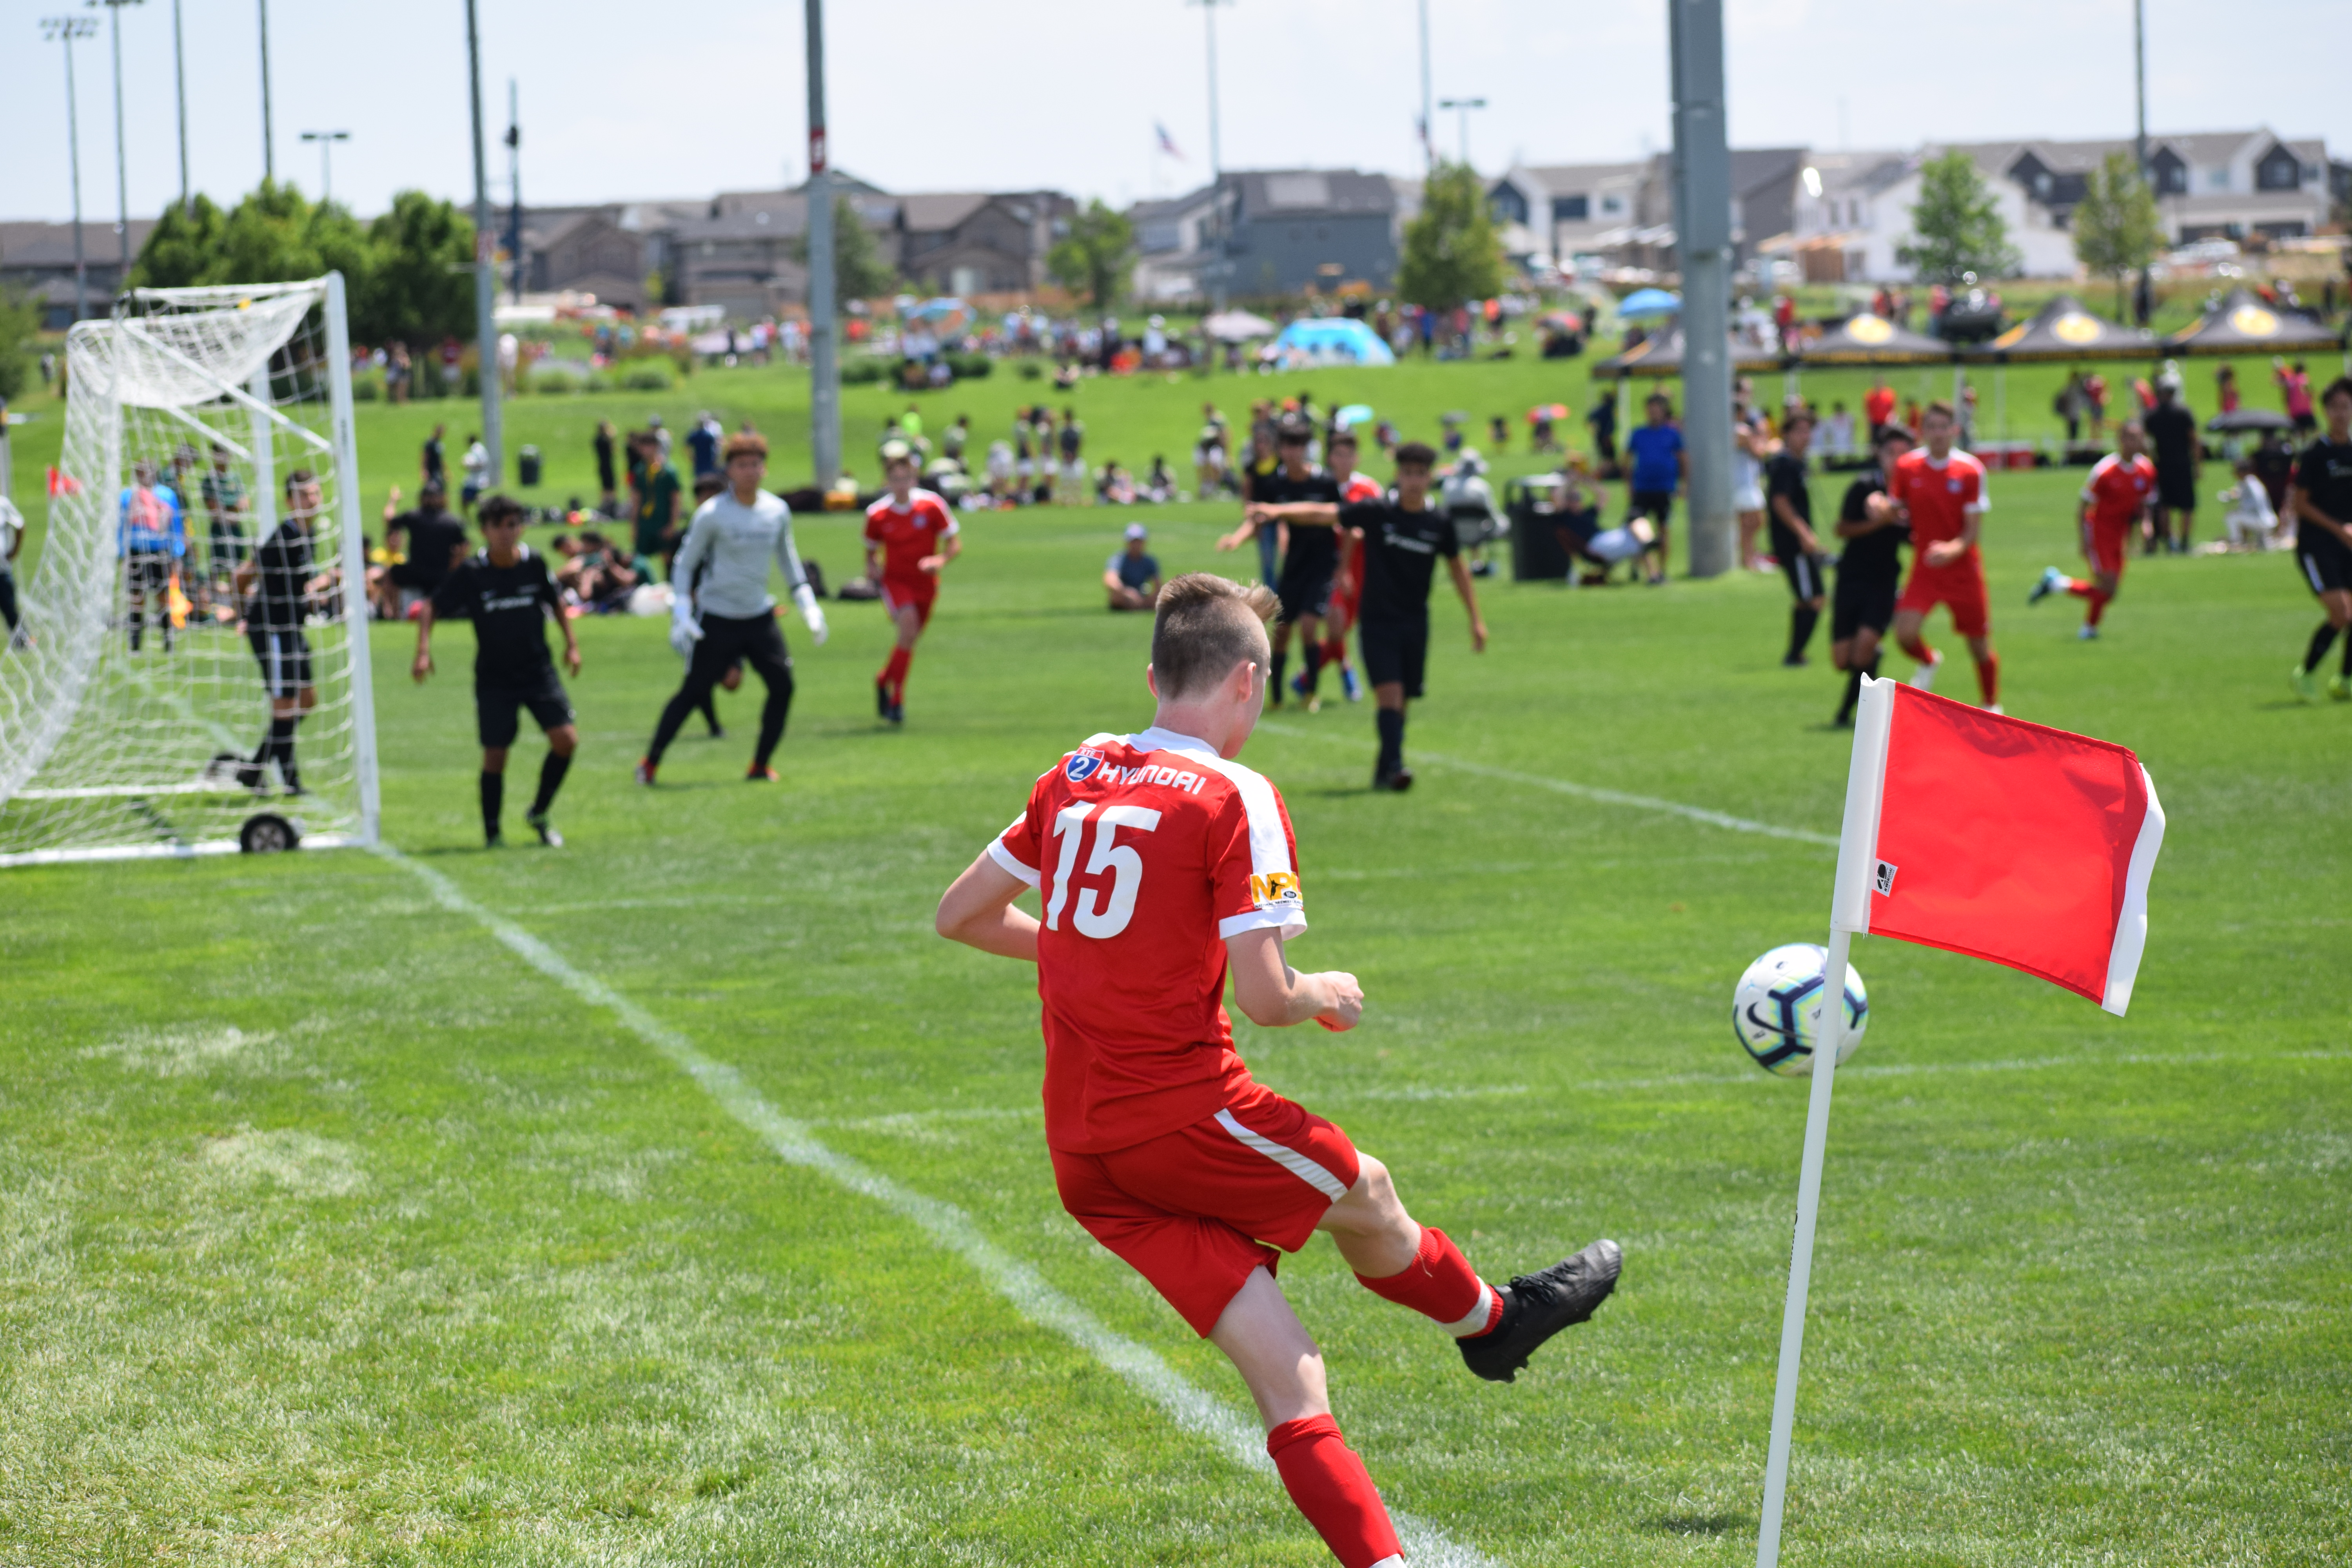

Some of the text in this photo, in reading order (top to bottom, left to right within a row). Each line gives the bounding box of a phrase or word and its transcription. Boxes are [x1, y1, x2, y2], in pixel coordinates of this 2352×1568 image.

[1081, 749, 1096, 757] RTE
[1070, 757, 1207, 795] 2 HYUNDAI
[1047, 800, 1162, 939] 15
[1251, 872, 1303, 902] NPL
